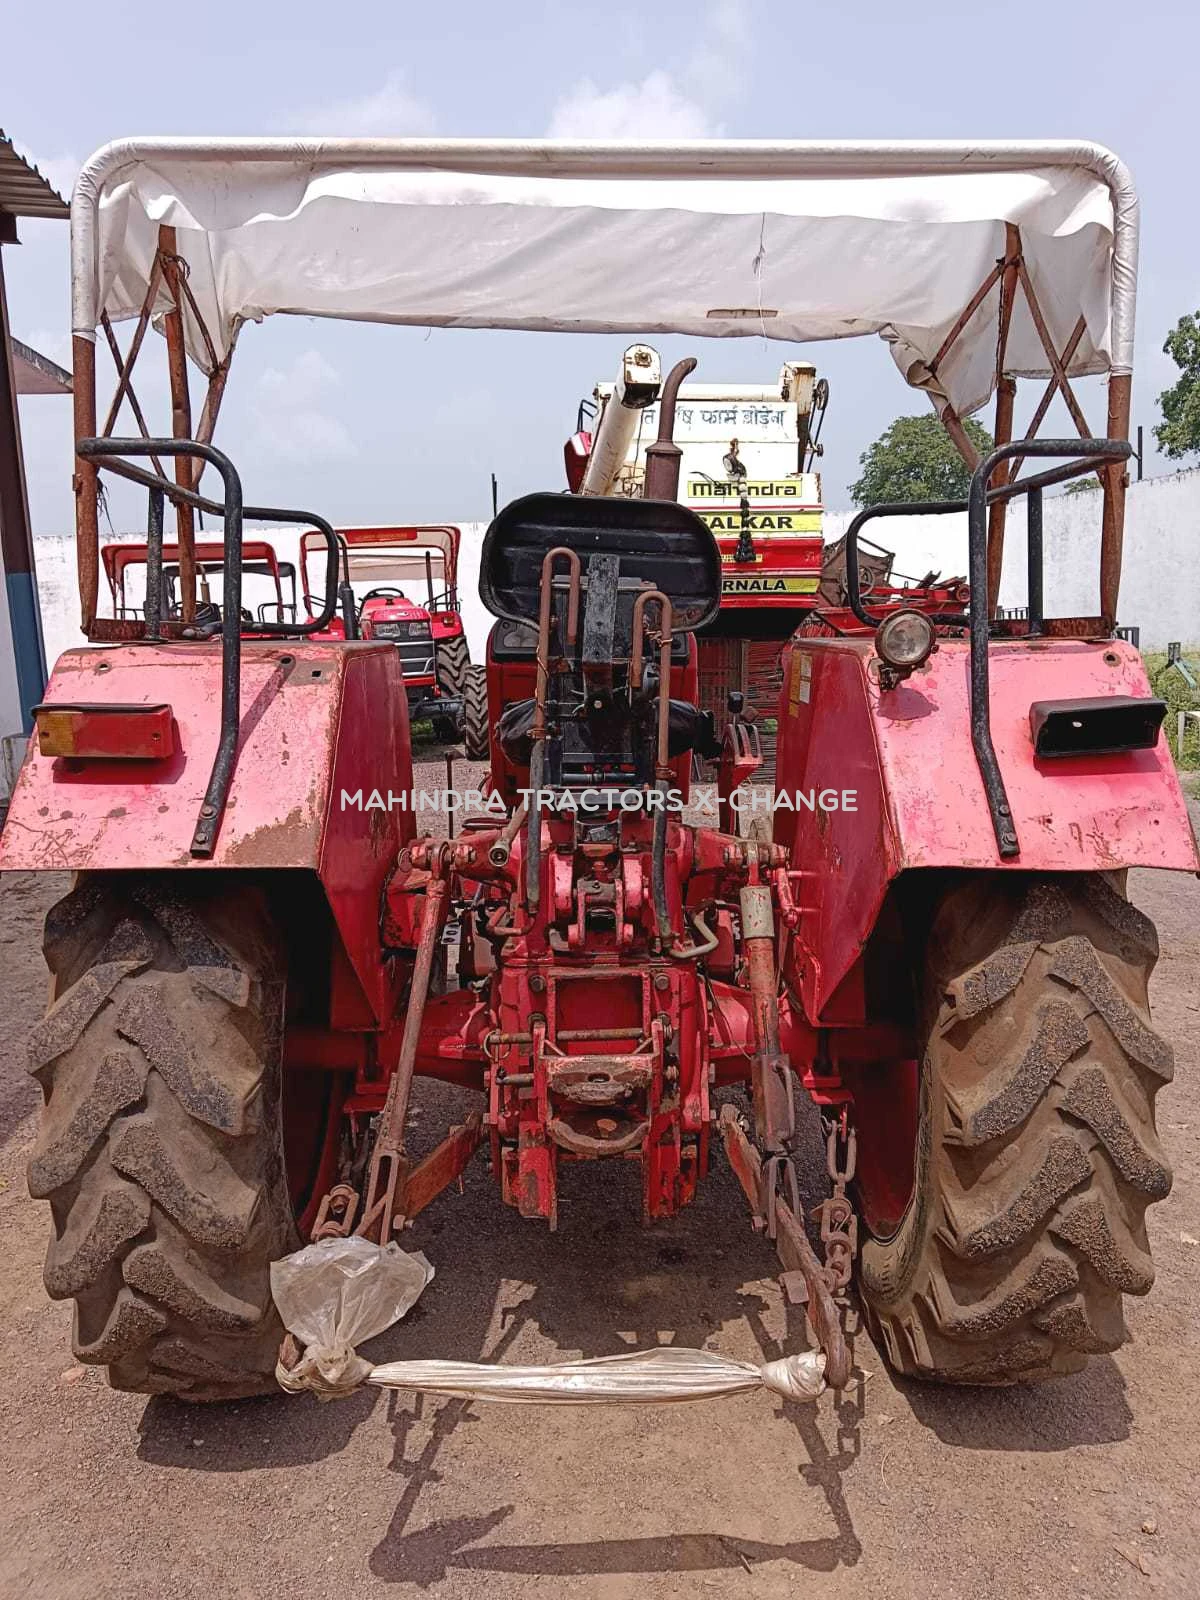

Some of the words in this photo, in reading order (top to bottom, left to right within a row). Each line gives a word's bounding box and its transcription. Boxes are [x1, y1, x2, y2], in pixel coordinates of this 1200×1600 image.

[692, 483, 797, 496] Mahndra
[701, 516, 793, 529] ALKAR
[722, 580, 787, 591] RNALA
